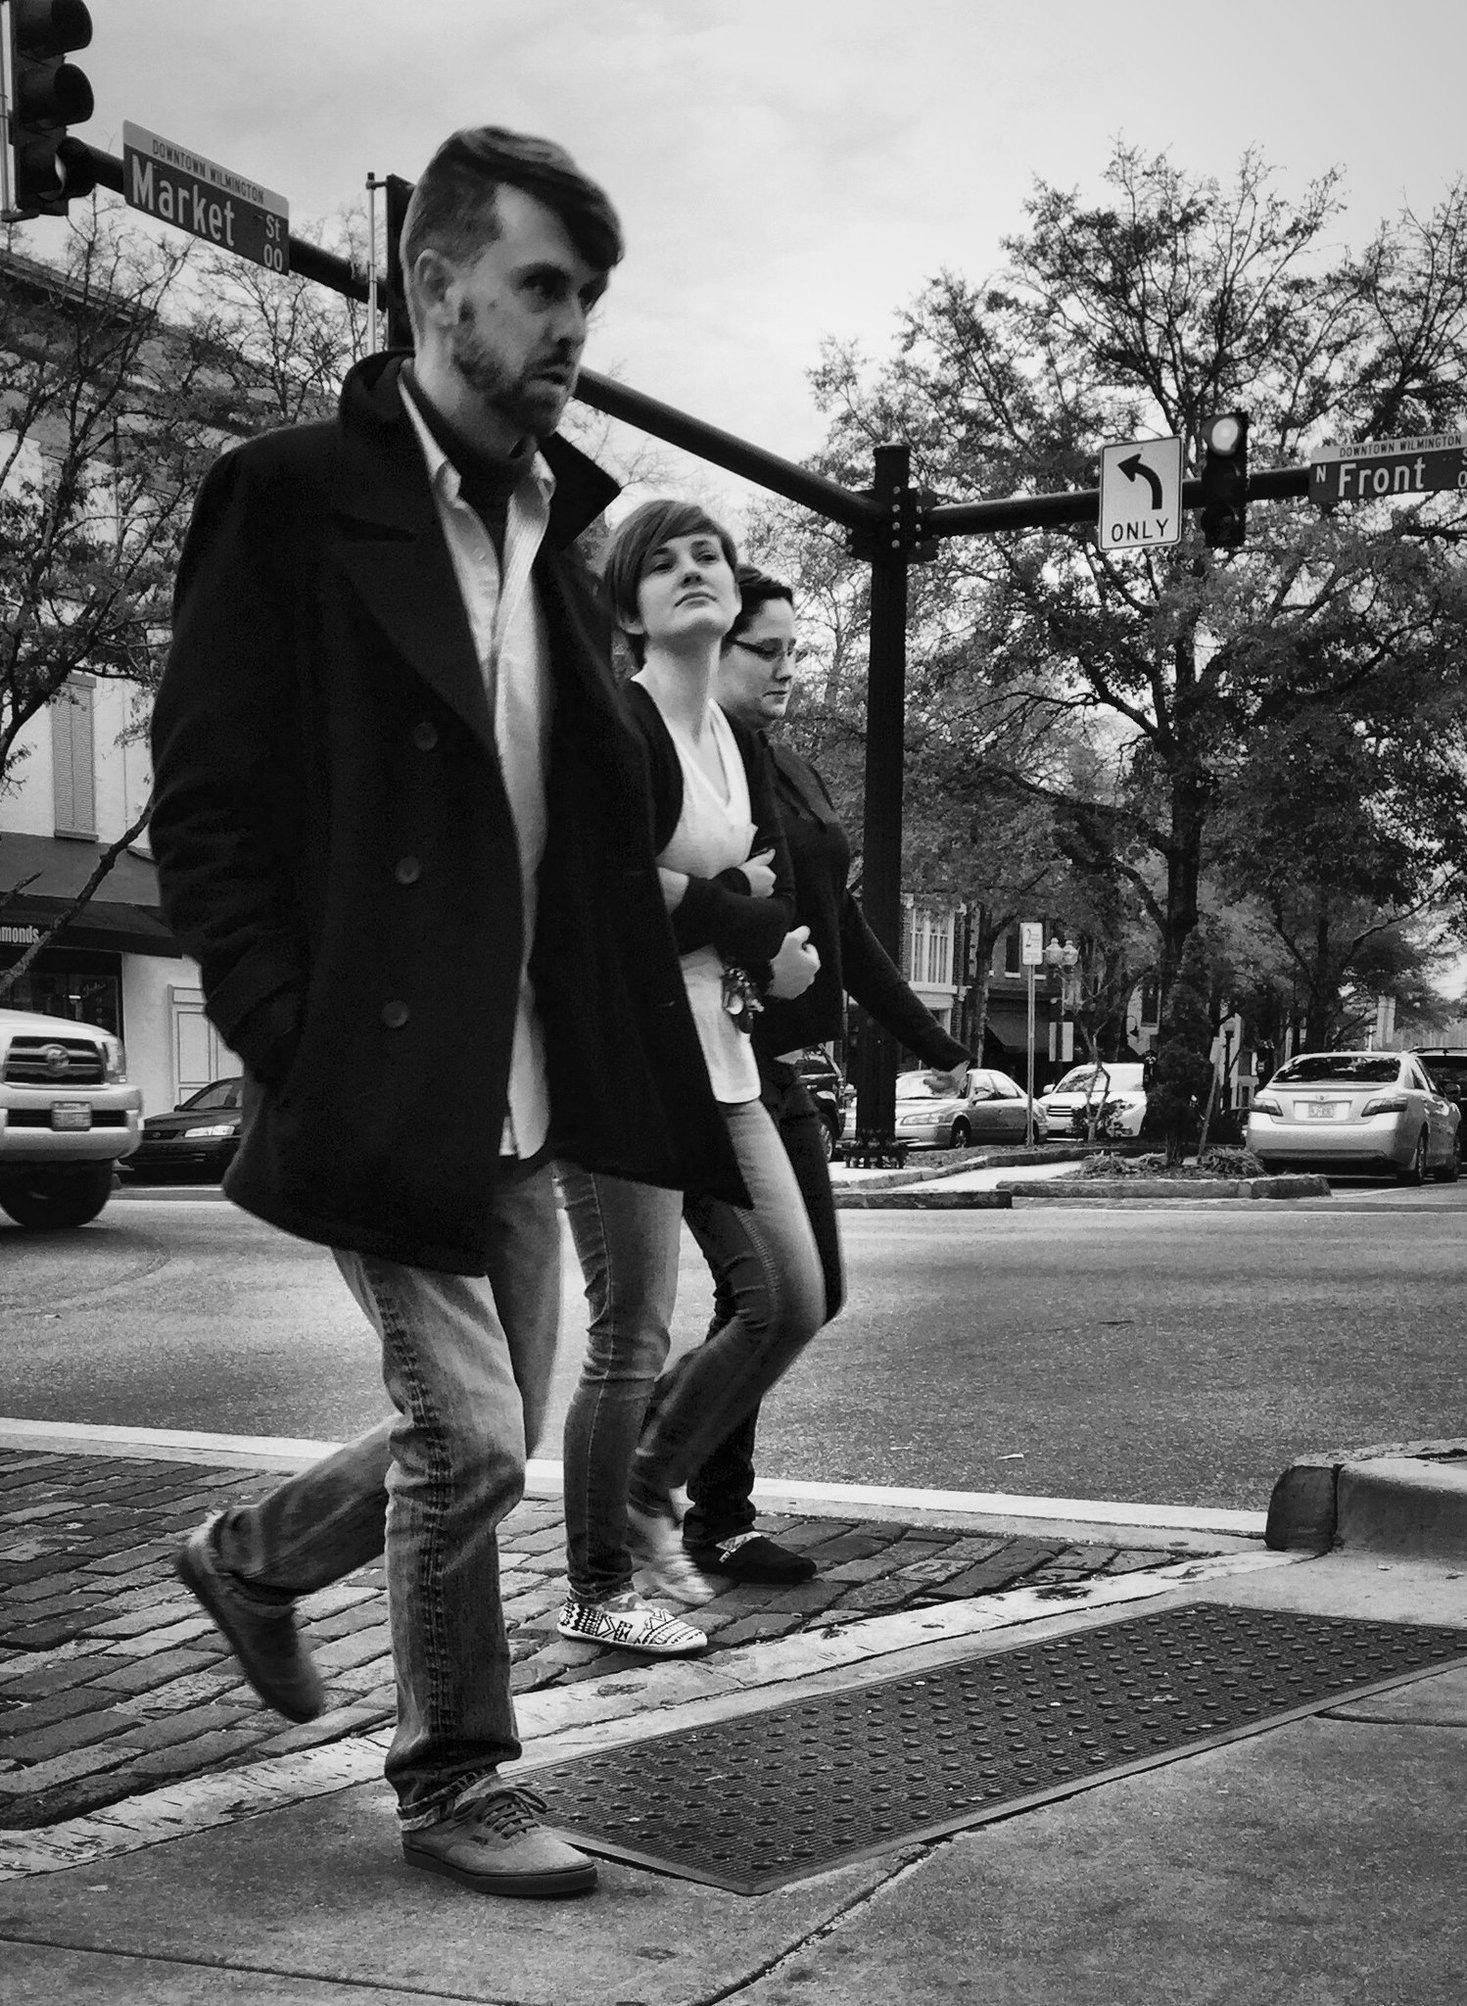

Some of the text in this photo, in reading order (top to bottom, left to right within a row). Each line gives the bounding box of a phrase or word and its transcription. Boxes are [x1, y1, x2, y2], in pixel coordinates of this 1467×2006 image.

[152, 139, 264, 204] DOWNTOWN WILMINGTON
[132, 153, 281, 247] Market St
[263, 243, 283, 272] 00
[1339, 435, 1462, 458] DOWNTOWN WILMINGTON
[1315, 464, 1327, 483] N
[1337, 456, 1426, 497] Front
[1111, 518, 1169, 543] ONLY
[0, 925, 40, 944] monds
